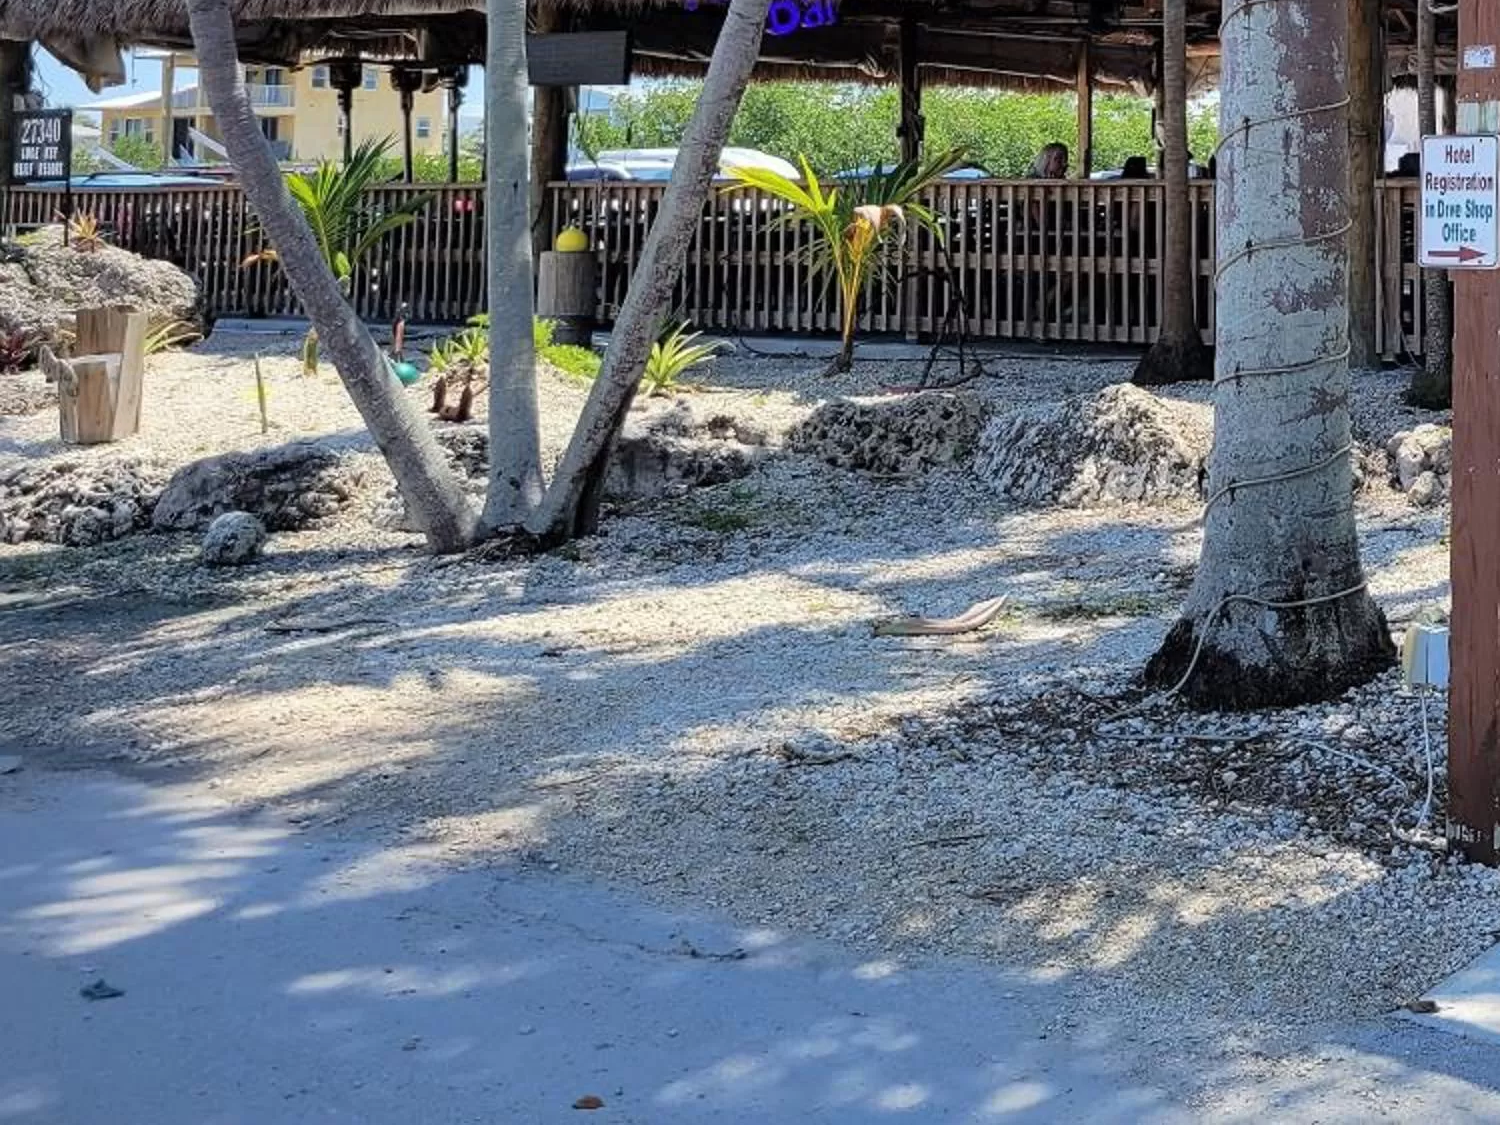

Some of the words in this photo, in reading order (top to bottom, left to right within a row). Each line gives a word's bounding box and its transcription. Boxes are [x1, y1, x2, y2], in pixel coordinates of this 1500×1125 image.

[21, 118, 61, 144] 27340
[1444, 144, 1475, 164] Hotel
[1425, 172, 1493, 196] Registration
[1425, 199, 1435, 218] in
[1437, 199, 1462, 218] Dive
[1465, 198, 1493, 223] Shop
[1442, 222, 1477, 243] Office
